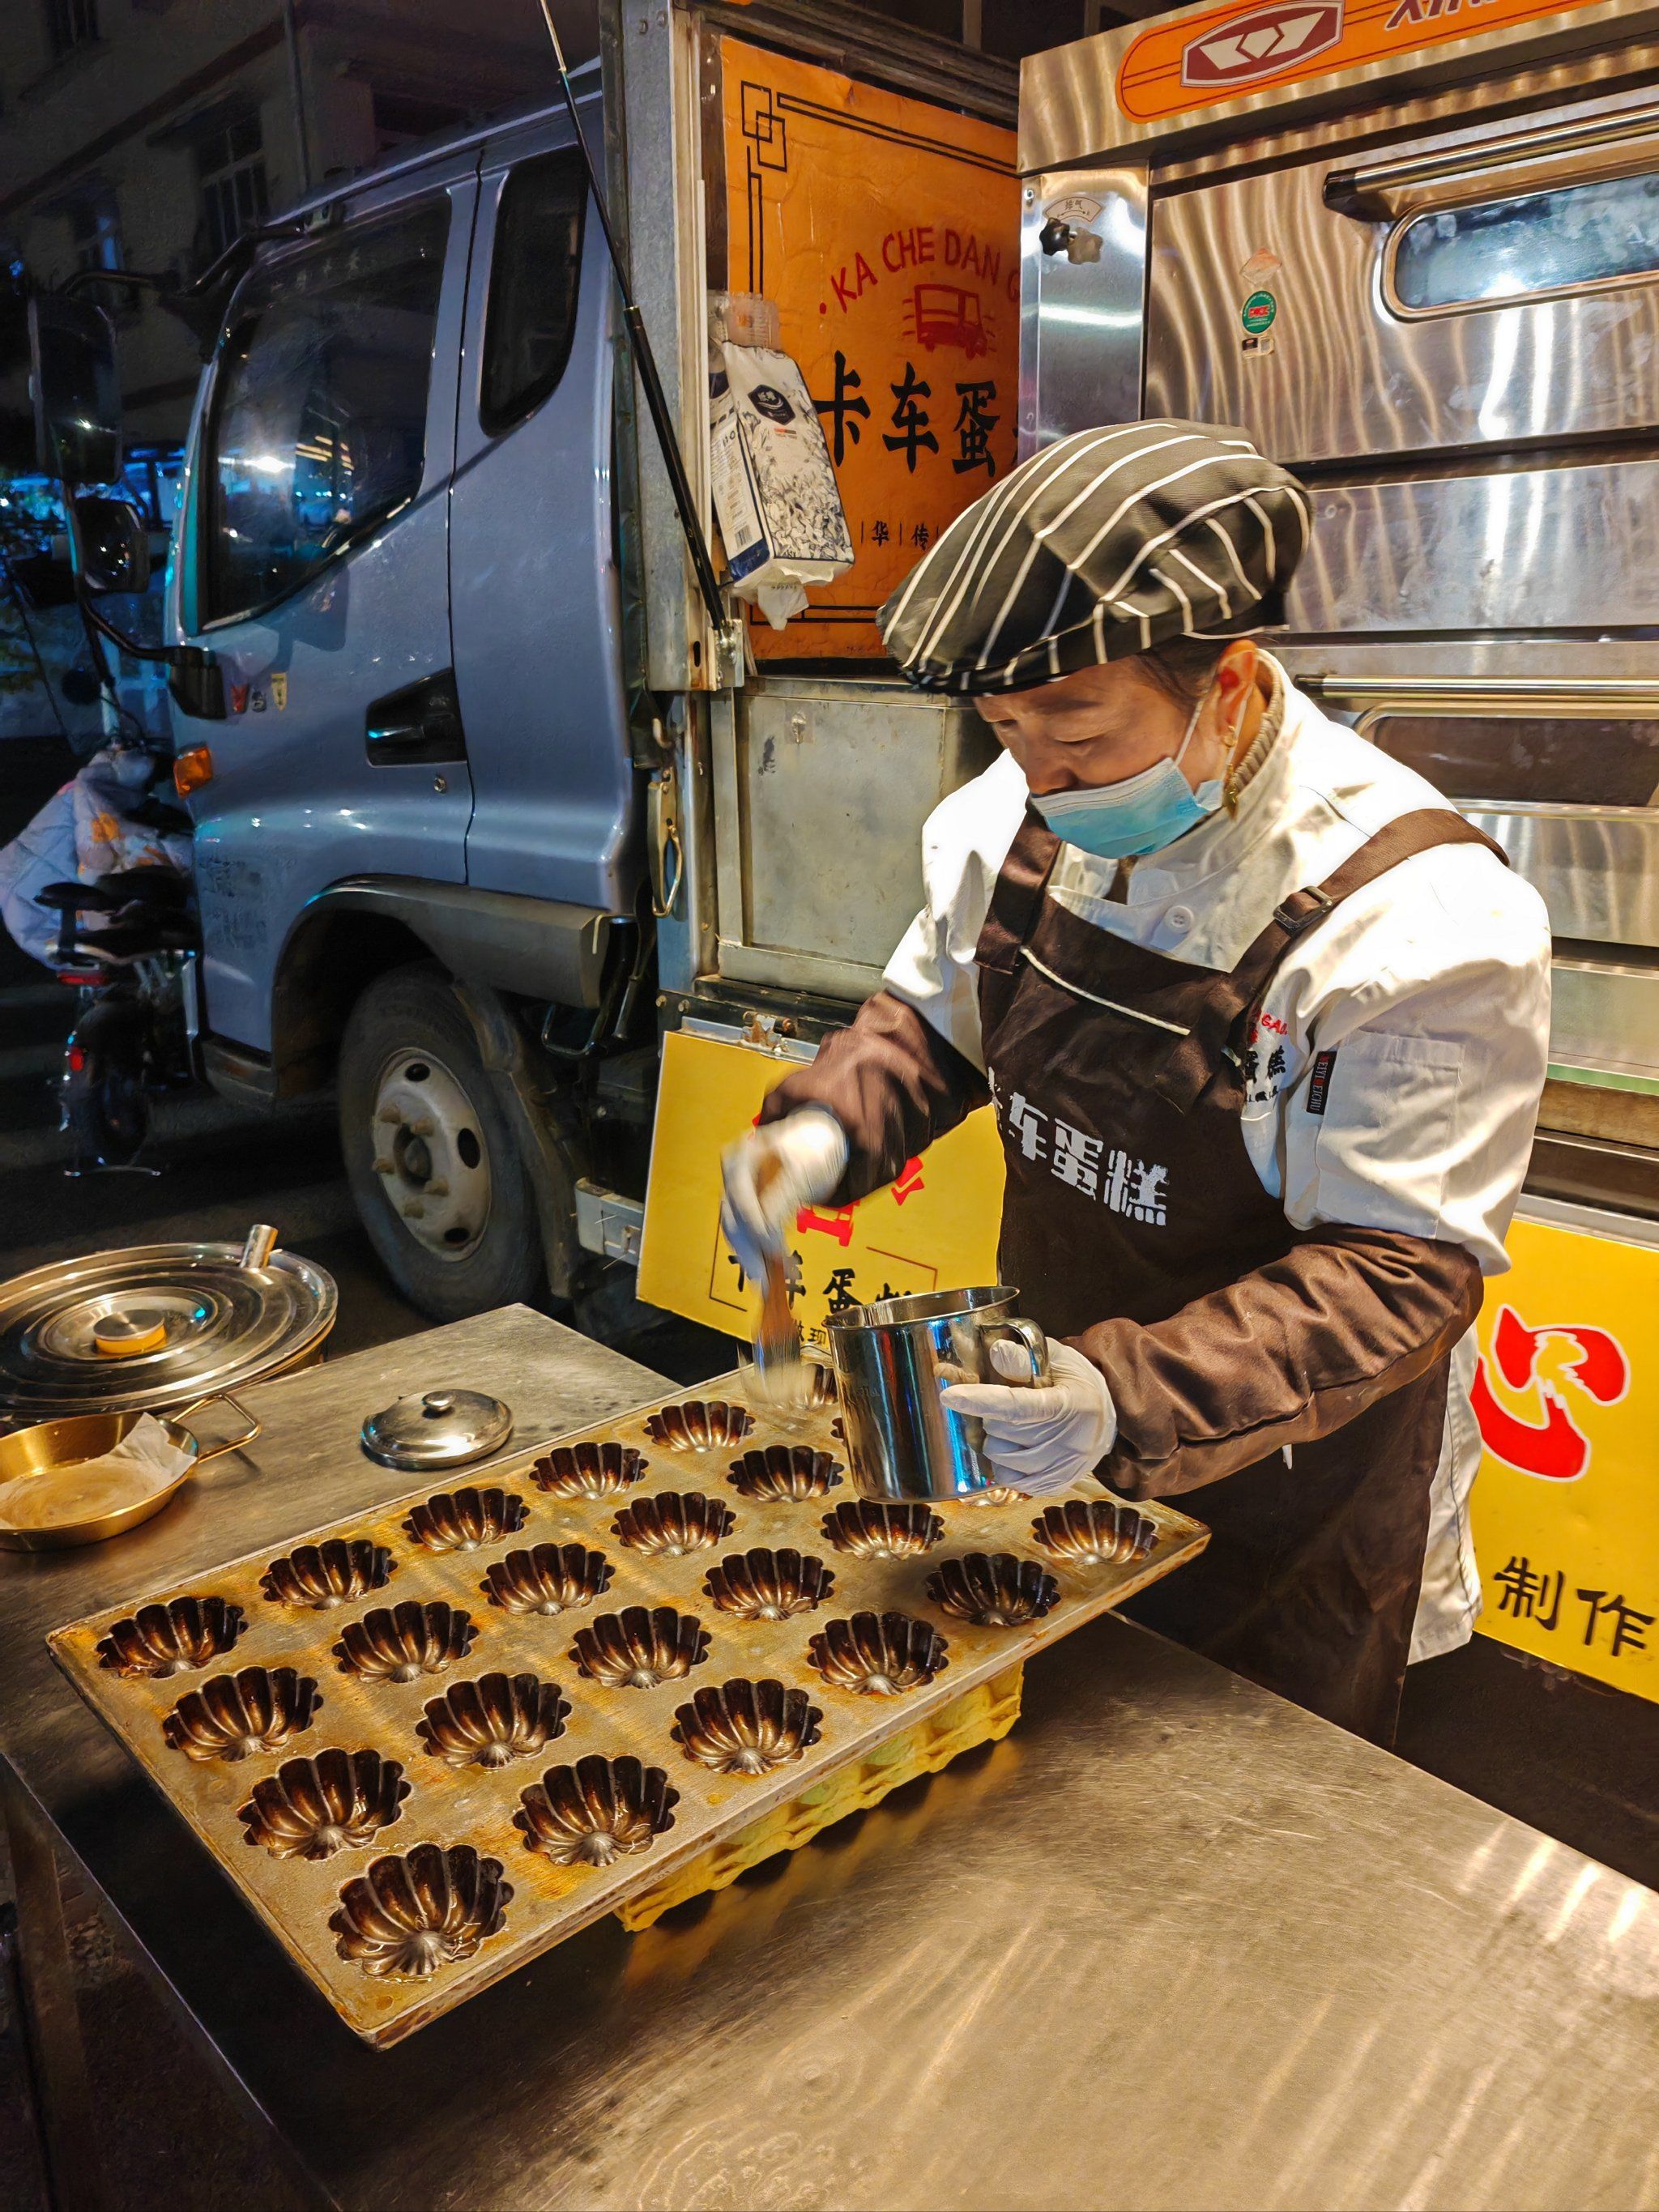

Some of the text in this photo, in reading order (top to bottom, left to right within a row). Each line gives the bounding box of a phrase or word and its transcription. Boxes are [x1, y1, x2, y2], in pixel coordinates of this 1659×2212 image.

[830, 252, 878, 313] KA
[882, 226, 936, 272] CHE
[945, 228, 1001, 285] DAN
[811, 350, 1018, 478] 卡车蛋
[987, 1066, 1170, 1226] 车蛋糕
[1494, 1555, 1657, 1657] 制作
